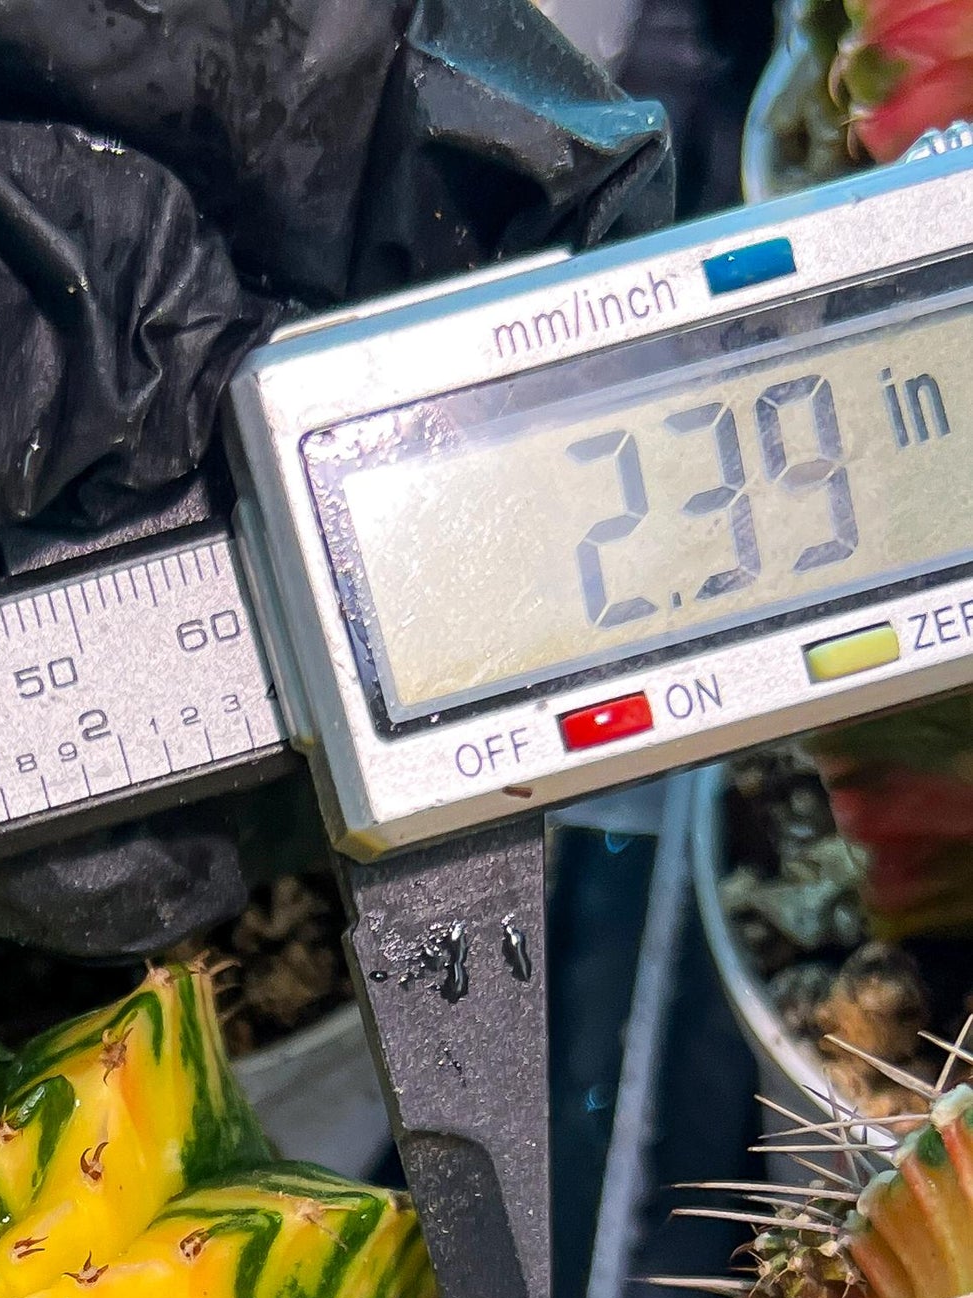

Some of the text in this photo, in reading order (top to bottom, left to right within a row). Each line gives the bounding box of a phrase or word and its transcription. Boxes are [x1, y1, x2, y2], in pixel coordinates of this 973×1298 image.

[493, 271, 679, 358] mm/inch
[566, 366, 951, 629] 2.39 in
[13, 657, 78, 699] 50
[176, 610, 241, 652] 60
[15, 753, 37, 773] 8
[58, 742, 78, 763] 9
[78, 709, 111, 742] 2
[150, 717, 158, 734] 1
[180, 707, 201, 726] 2
[222, 693, 242, 713] 3
[454, 675, 725, 779] OFF ON
